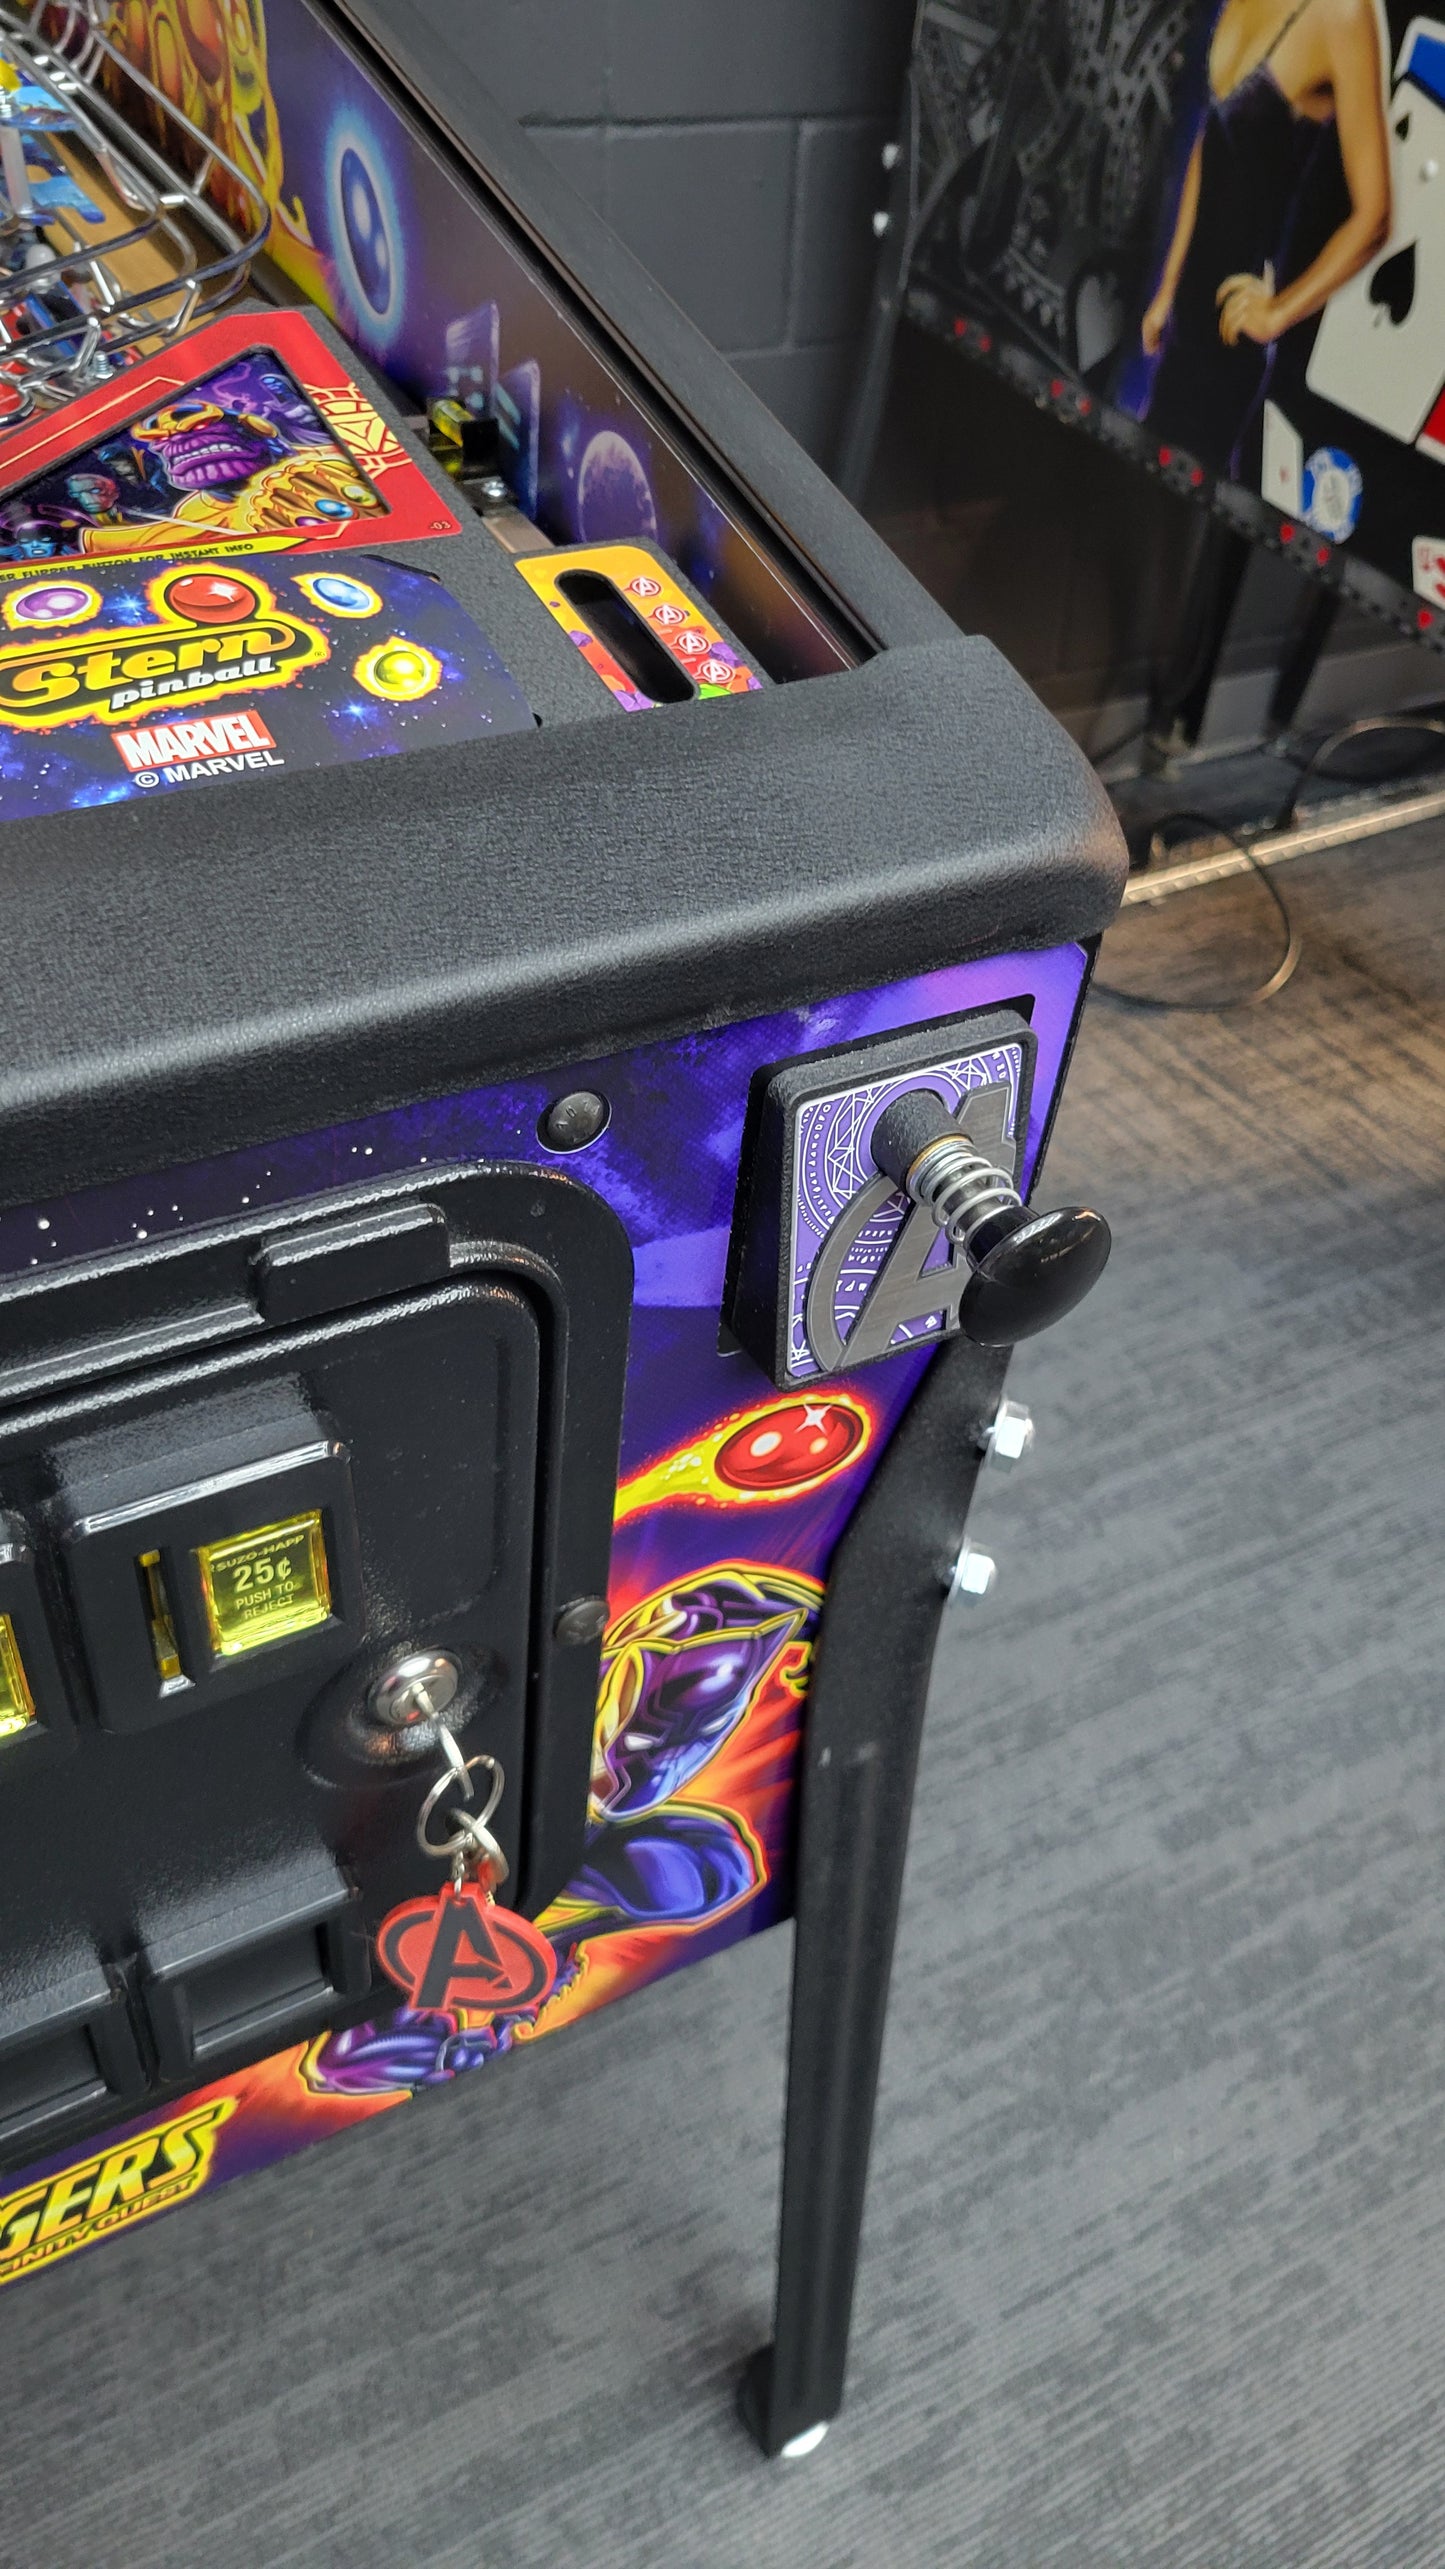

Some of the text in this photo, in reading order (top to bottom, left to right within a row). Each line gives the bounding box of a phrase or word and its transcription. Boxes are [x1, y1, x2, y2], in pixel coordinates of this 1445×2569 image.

[170, 547, 220, 559] INSTANT
[225, 543, 254, 553] INFO
[12, 630, 276, 701] Stern
[110, 657, 275, 710] pinball
[117, 710, 270, 768] MARVEL
[165, 750, 285, 784] MARVEL
[216, 1534, 304, 1572] SUZO-HAPP
[233, 1556, 292, 1593] 25¢
[235, 1581, 294, 1610] PUSH TO
[244, 1593, 295, 1619] REJECT
